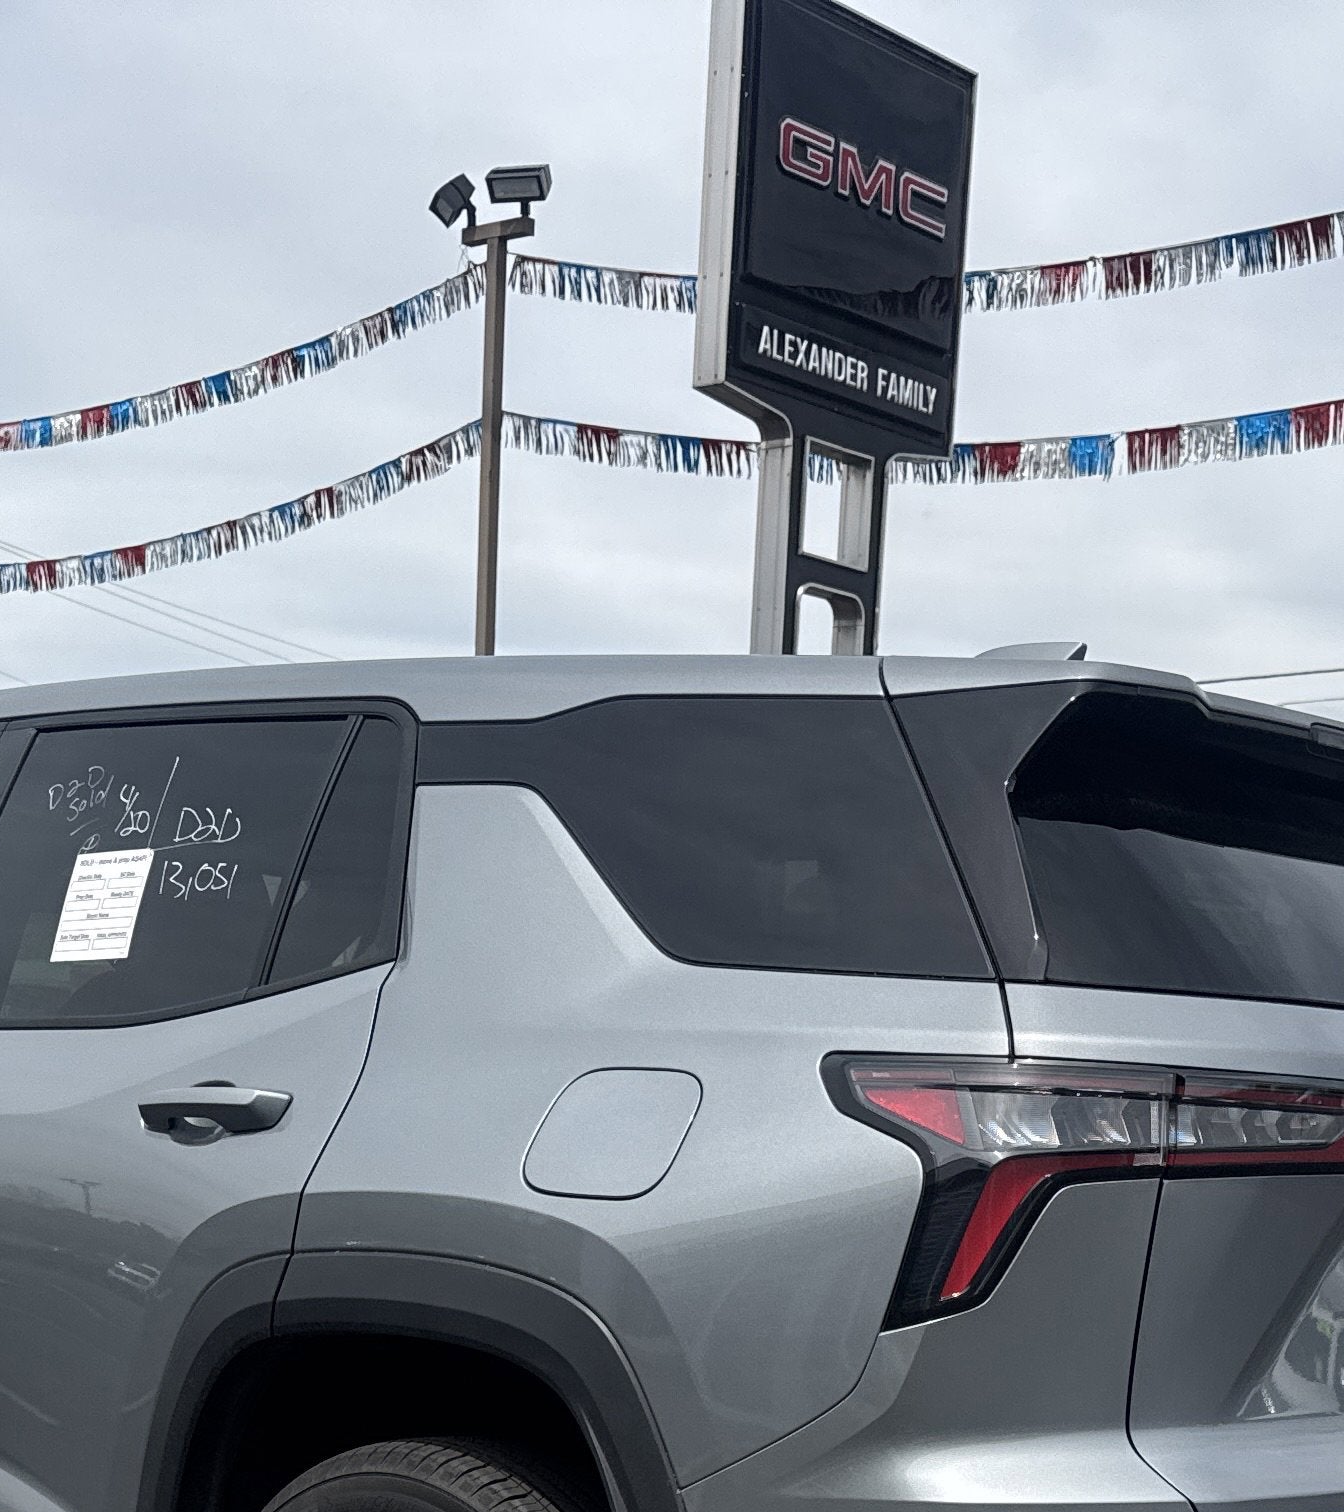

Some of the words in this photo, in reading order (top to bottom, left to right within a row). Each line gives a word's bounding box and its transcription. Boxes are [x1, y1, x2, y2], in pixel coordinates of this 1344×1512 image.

[780, 117, 948, 239] GMC
[759, 325, 868, 392] ALEXANDER
[877, 367, 937, 415] FAMILY
